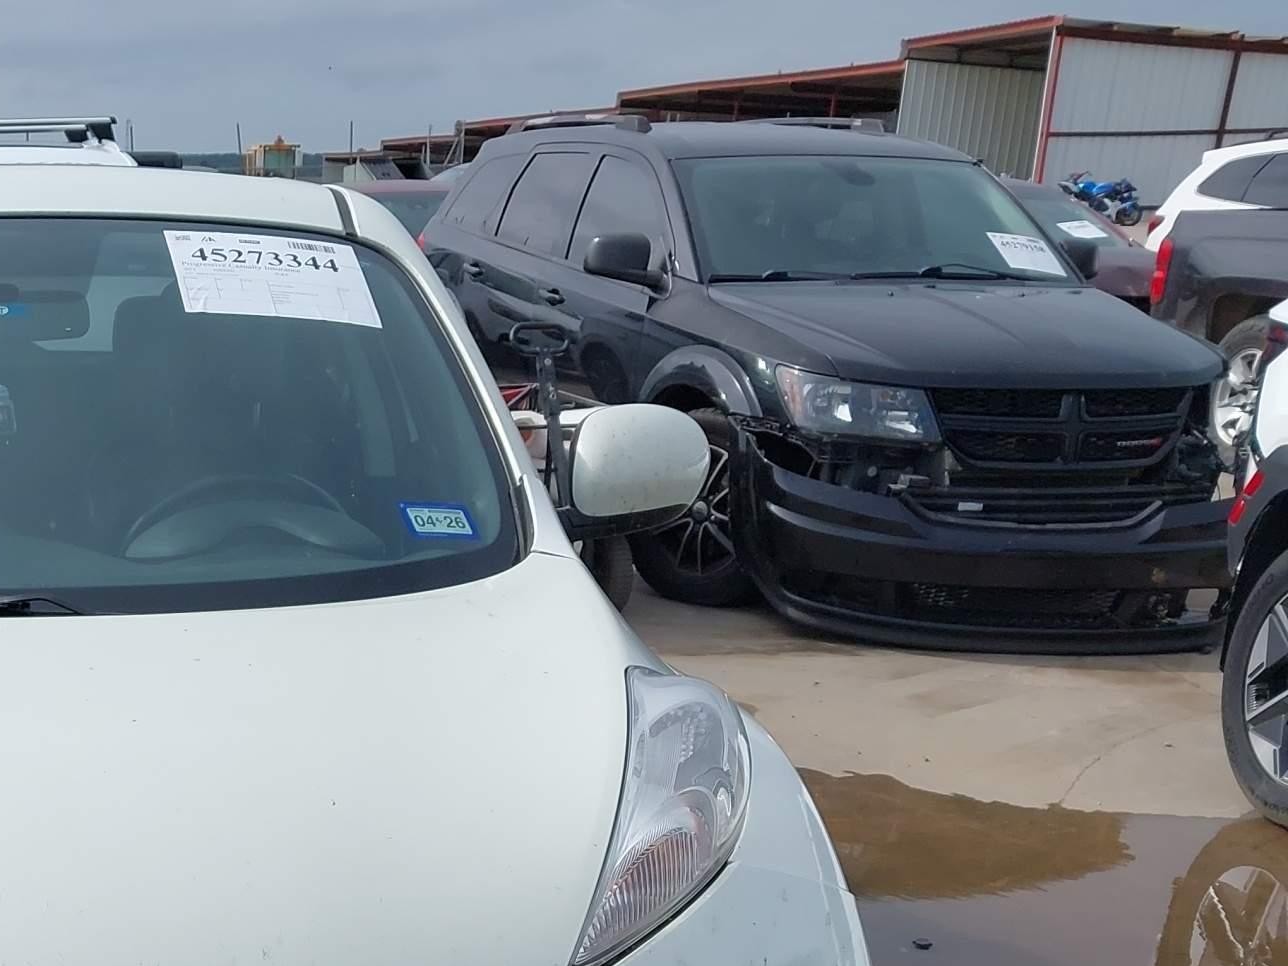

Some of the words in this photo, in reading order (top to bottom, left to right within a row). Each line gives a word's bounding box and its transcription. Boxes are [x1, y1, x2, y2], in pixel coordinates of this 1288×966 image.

[191, 247, 339, 273] 45273344
[414, 515, 436, 528] 04
[444, 516, 466, 529] 26
